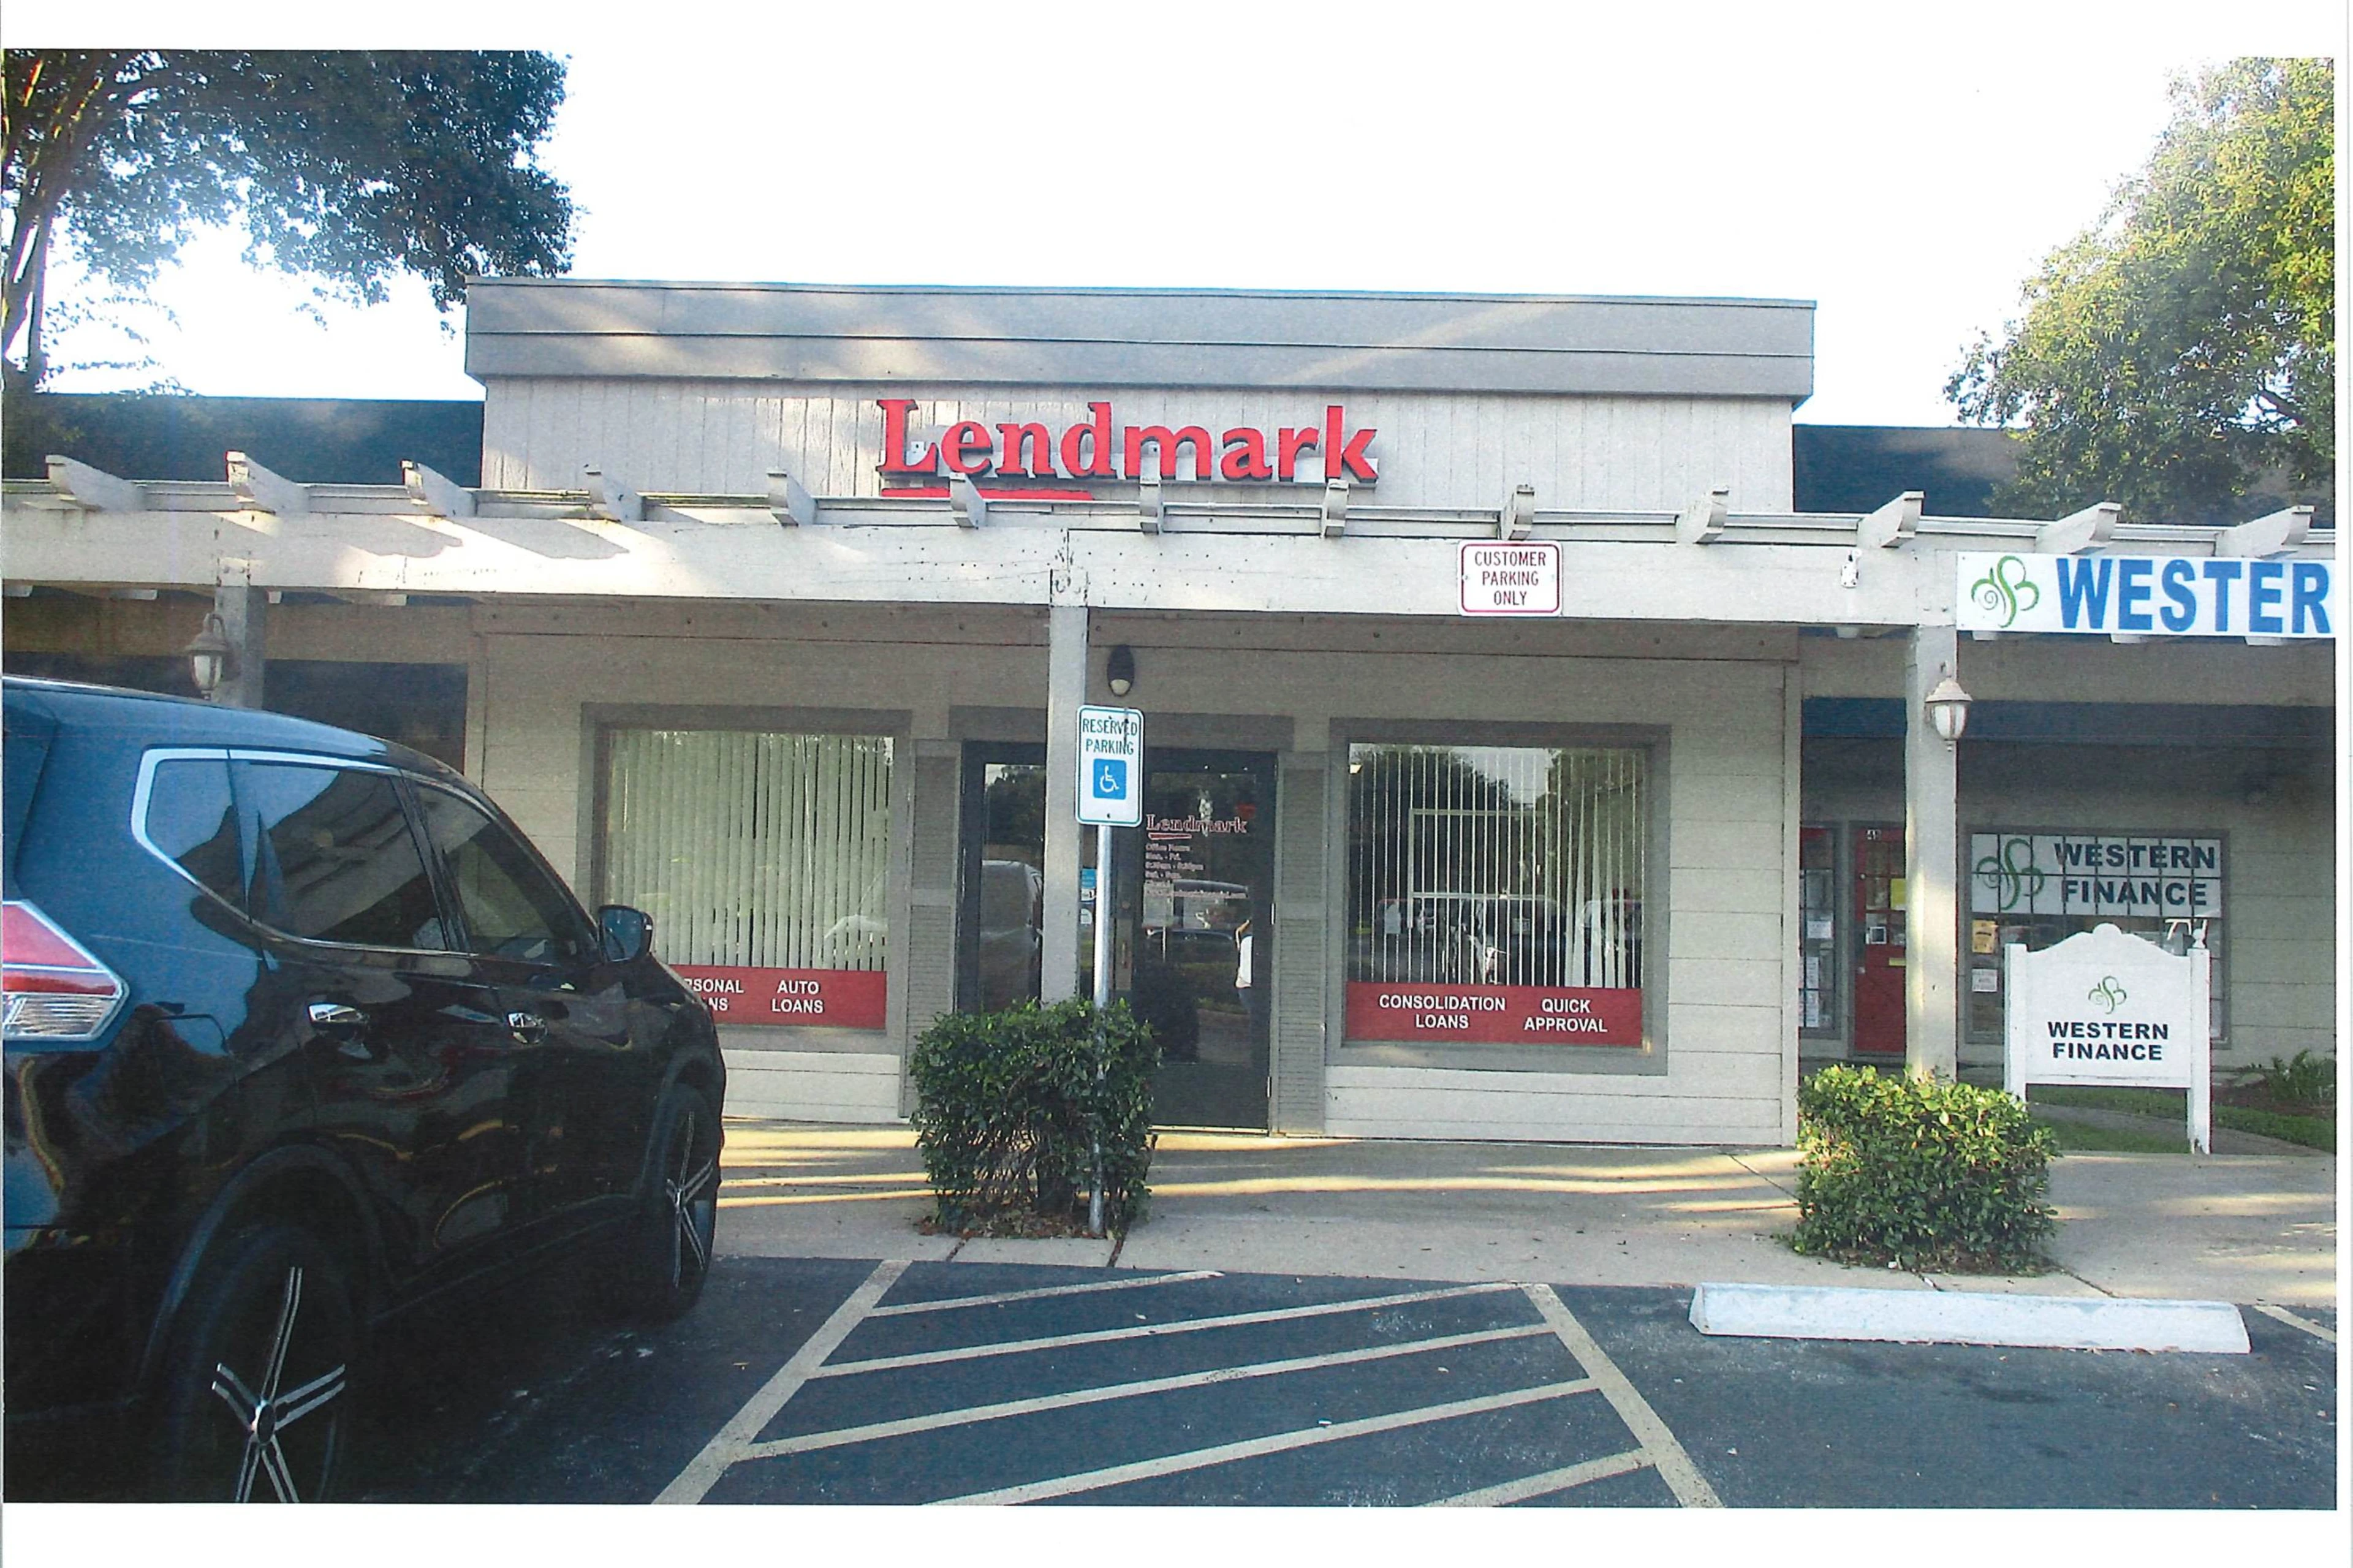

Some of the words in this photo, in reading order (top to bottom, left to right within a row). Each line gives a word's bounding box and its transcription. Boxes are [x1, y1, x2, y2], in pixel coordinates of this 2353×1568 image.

[876, 398, 1379, 482] Lendmark
[1474, 551, 1547, 567] CUSTOMER
[1482, 570, 1539, 586] PARKING
[1493, 590, 1528, 606] ONLY
[2055, 557, 2331, 634] WESTER
[1082, 718, 1138, 737] RESERVED
[1085, 738, 1134, 756] PARKING
[1146, 814, 1248, 833] Lendmark
[2054, 843, 2215, 869] WESTERN
[2061, 879, 2207, 906] FINANCE
[777, 980, 820, 995] AUTO
[771, 998, 824, 1013] LOANS
[1378, 993, 1506, 1011] CONSOLIDATION
[1541, 998, 1591, 1013] QUICK
[1415, 1013, 1469, 1029] LOANS
[1523, 1015, 1608, 1033] APPROVAL
[2047, 1021, 2169, 1040] WESTERN
[2053, 1042, 2162, 1061] FINANCE
